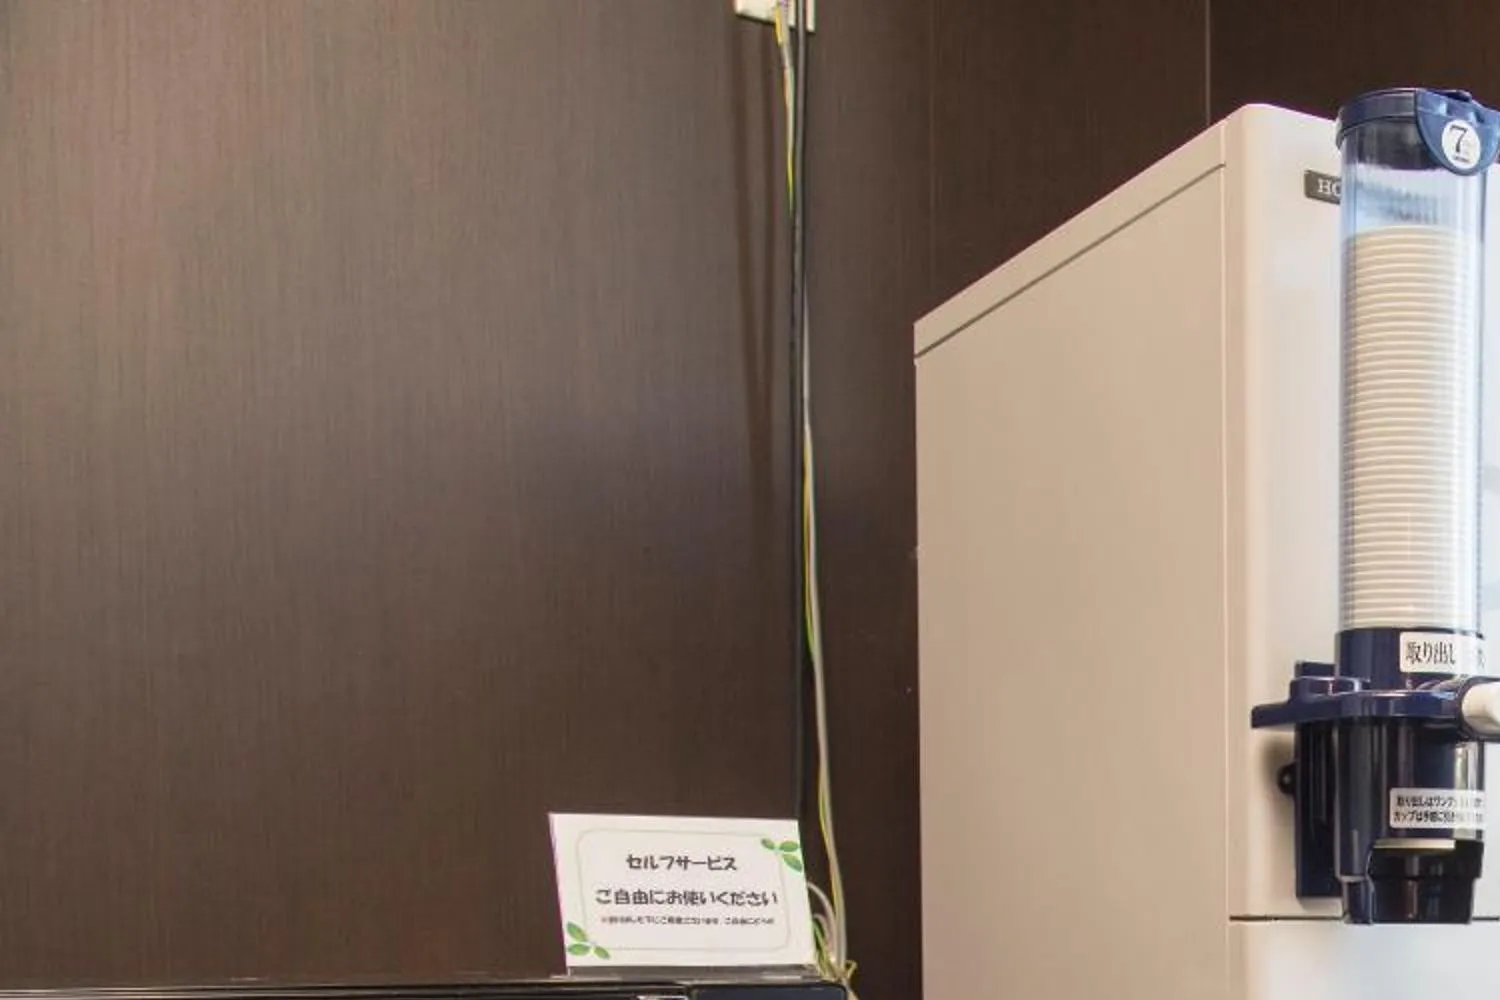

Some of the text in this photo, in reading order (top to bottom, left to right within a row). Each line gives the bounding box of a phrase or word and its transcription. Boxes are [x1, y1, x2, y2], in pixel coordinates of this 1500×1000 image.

[1449, 124, 1468, 153] 7
[1405, 640, 1456, 665] 取り出し
[626, 854, 738, 872] セルフサービス
[595, 887, 778, 906] ご自由にお使いください
